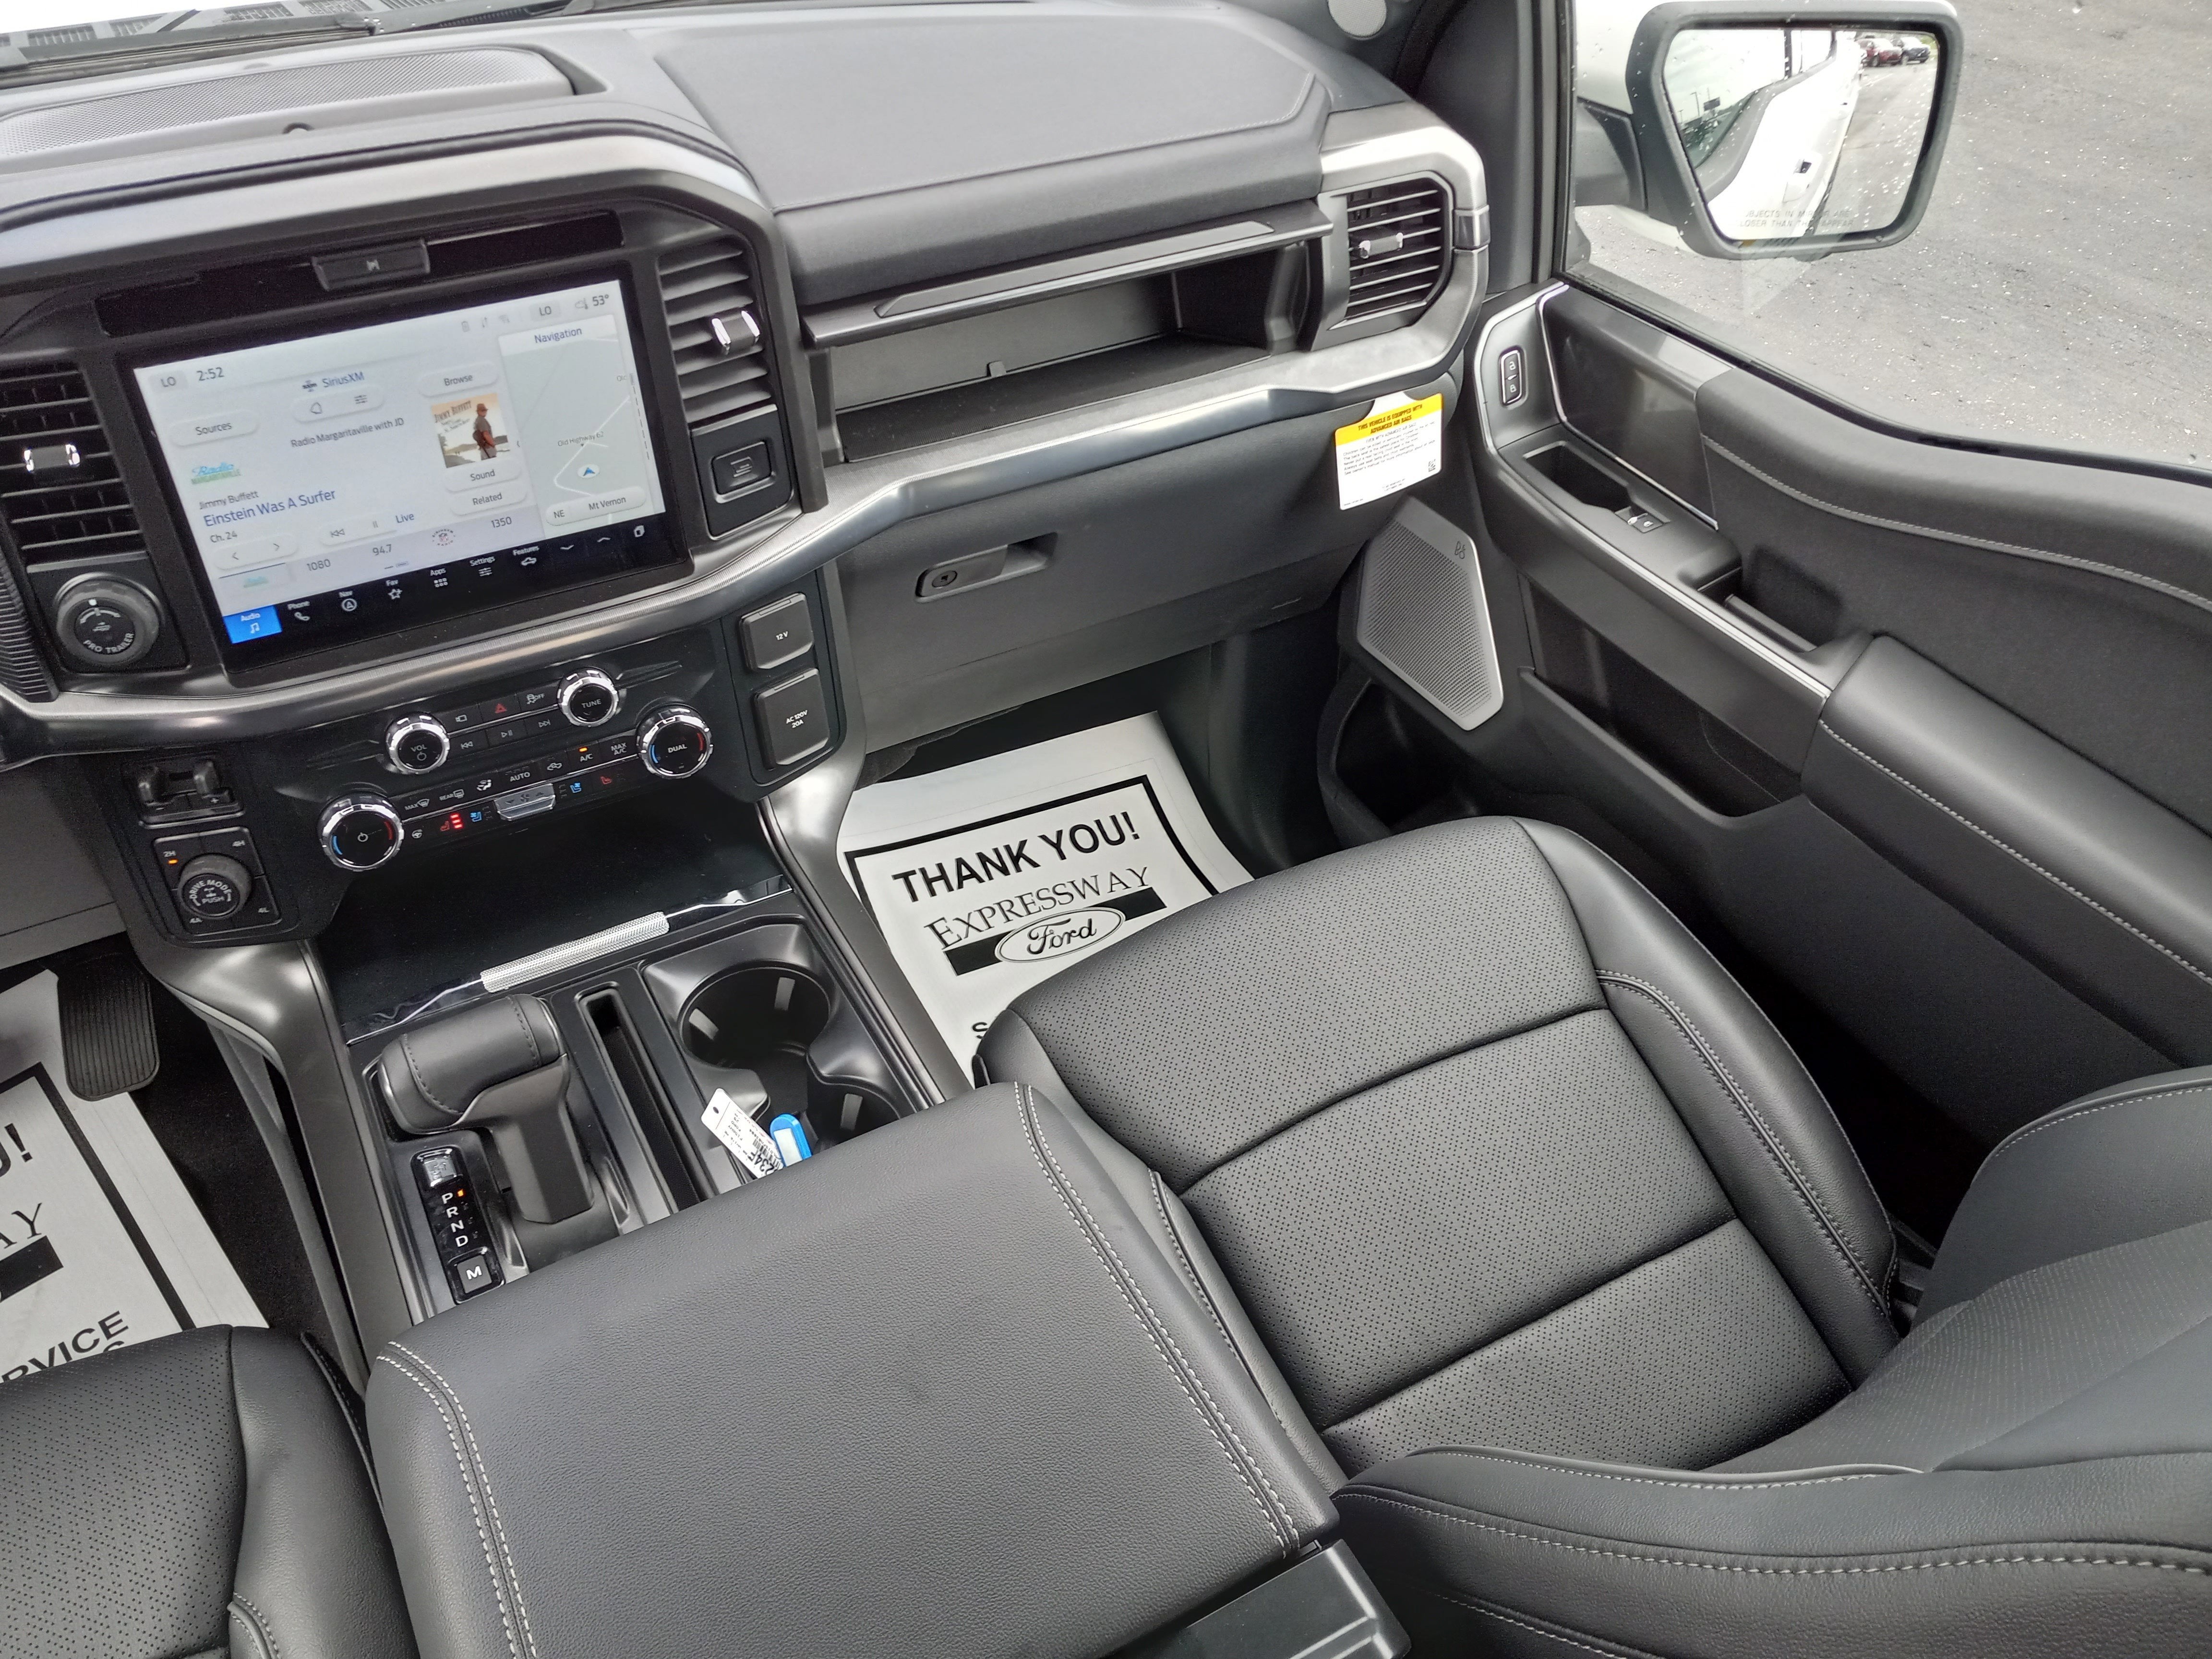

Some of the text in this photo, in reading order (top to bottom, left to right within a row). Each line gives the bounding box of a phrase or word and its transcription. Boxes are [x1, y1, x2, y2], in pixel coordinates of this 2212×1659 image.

[592, 294, 609, 306] 53°
[539, 306, 552, 316] LO
[534, 328, 582, 343] Navigation
[197, 367, 225, 381] 2:52
[322, 372, 365, 387] SiriusXM
[444, 374, 473, 386] Browse
[161, 377, 176, 387] LO
[195, 423, 232, 435] Sources
[291, 417, 404, 447] Radio Margaritaville with JD
[569, 433, 596, 445] Highway
[470, 469, 495, 481] Sound
[199, 490, 259, 509] Jimmy Buffett
[472, 492, 503, 505] Related
[589, 496, 626, 511] Mt Vernon
[204, 490, 336, 527] Einstein Was A Surfer
[553, 509, 565, 519] NE
[395, 513, 415, 524] Live
[491, 516, 513, 529] 1350
[210, 530, 238, 543] Ch. 24
[373, 543, 392, 556] 94.7
[513, 545, 540, 556] Features
[307, 558, 331, 571] 1080
[469, 556, 496, 567] Settings
[430, 567, 446, 577] Apps
[339, 590, 353, 598] Nav
[288, 601, 311, 610] Phone
[240, 612, 261, 622] Audio
[83, 633, 134, 653] PRO TRAILER
[581, 698, 601, 709] TUNE
[792, 720, 804, 728] 20A
[410, 744, 427, 752] VOL
[611, 743, 627, 751] MAX
[614, 747, 627, 756] A/C
[668, 744, 687, 754] DUAL
[580, 754, 593, 762] A/C
[510, 771, 530, 782] AUTO
[439, 793, 454, 801] REAR
[891, 811, 1141, 903] THANK YOU!
[189, 879, 232, 899] DRIVE MODE
[202, 896, 225, 904] PUSH
[924, 866, 1150, 950] EXPRESSWAY
[1026, 917, 1097, 955] Ford
[442, 1192, 453, 1204] P
[446, 1206, 458, 1218] R
[451, 1220, 464, 1232] N
[456, 1235, 469, 1247] D
[466, 1266, 482, 1280] M
